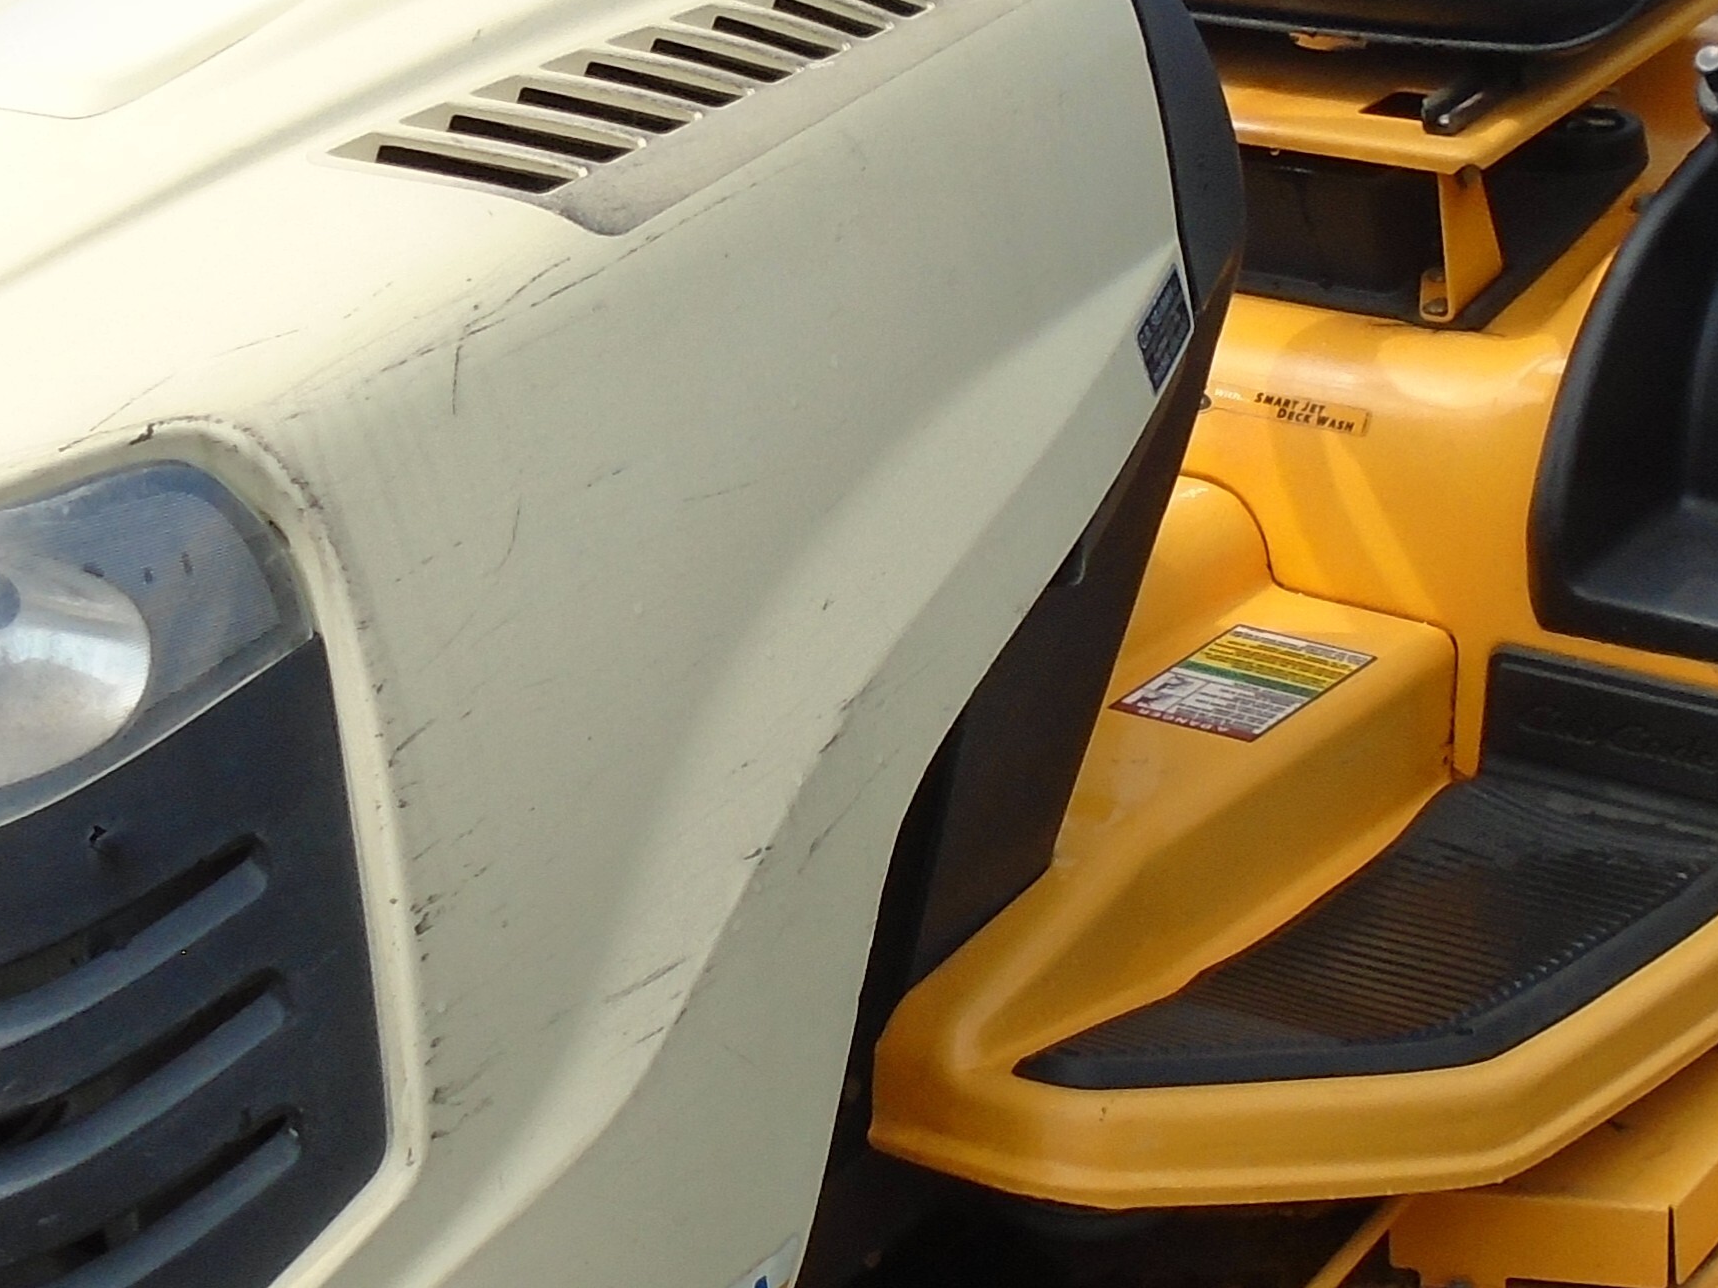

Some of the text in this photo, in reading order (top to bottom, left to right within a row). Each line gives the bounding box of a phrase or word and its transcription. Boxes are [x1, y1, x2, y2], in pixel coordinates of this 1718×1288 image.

[1253, 392, 1301, 409] SMART
[1301, 401, 1326, 414] JET
[1276, 408, 1355, 433] DECK WASH
